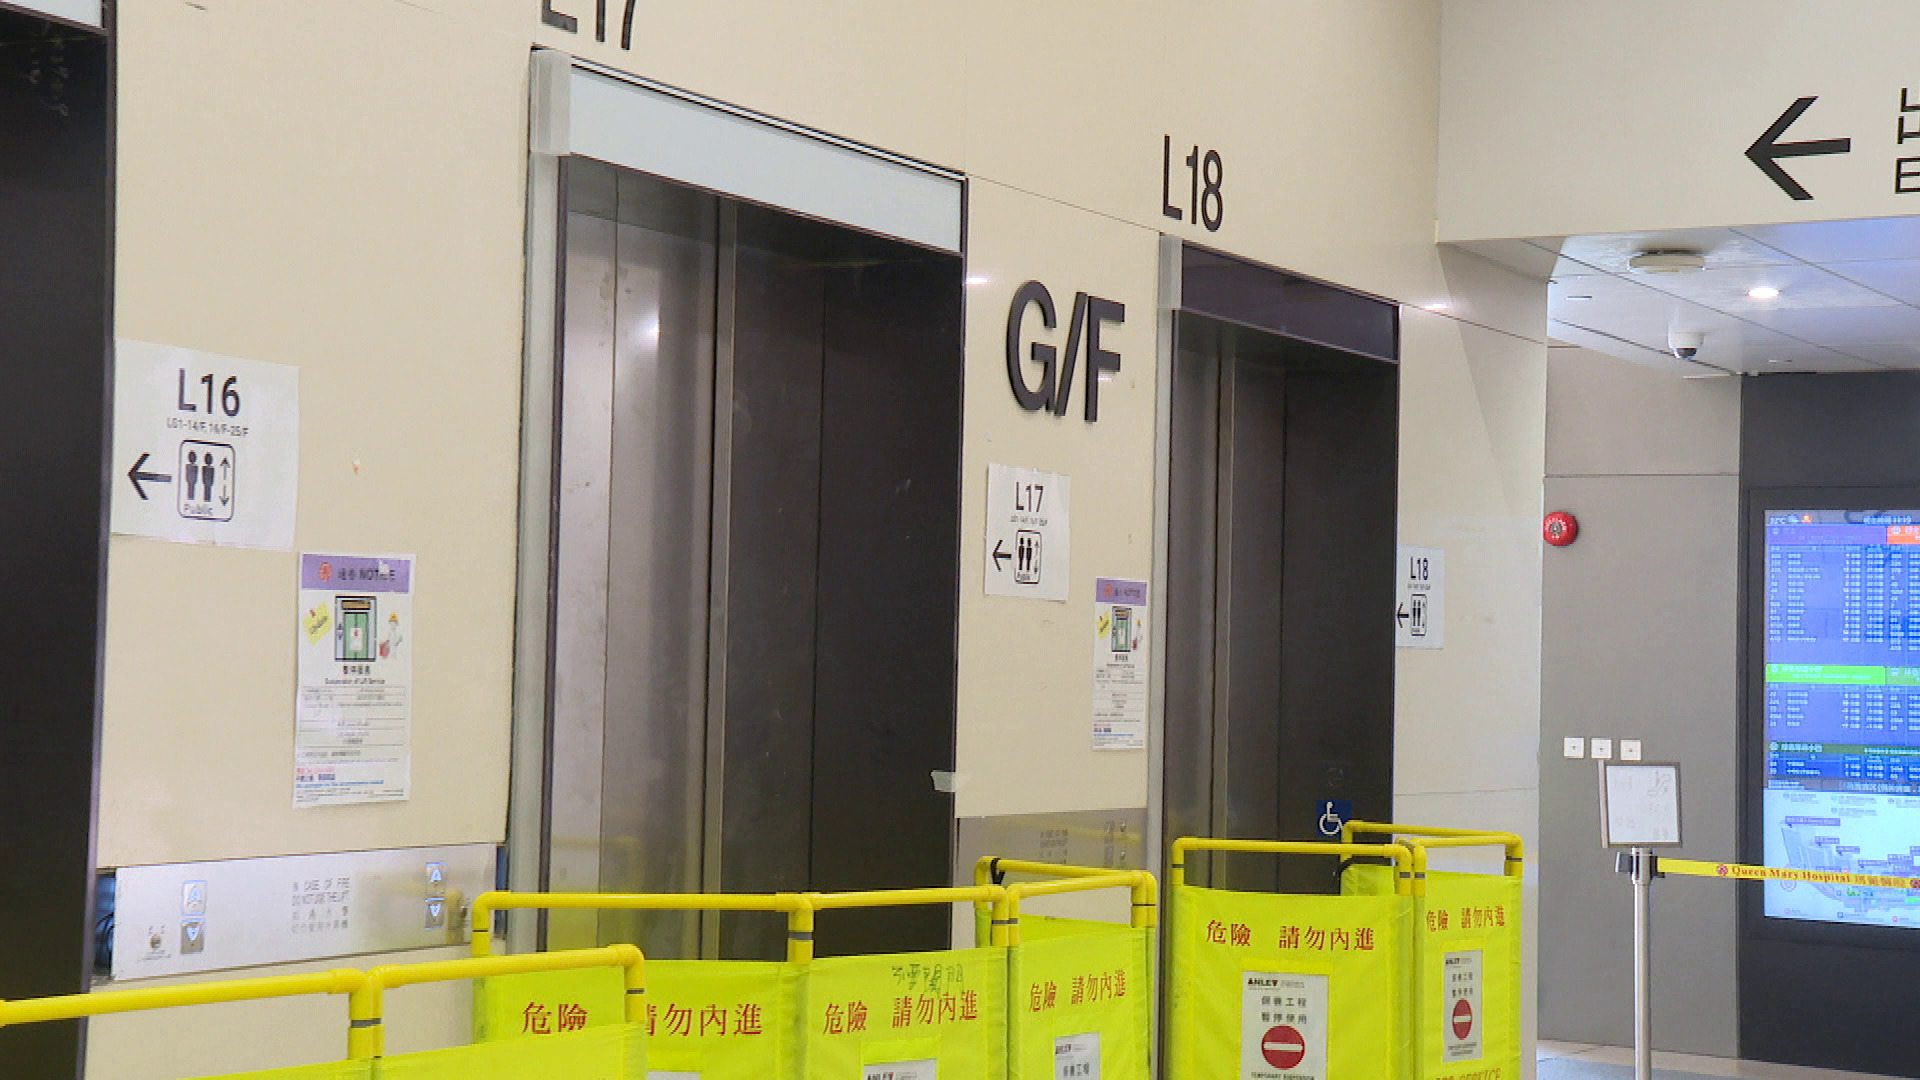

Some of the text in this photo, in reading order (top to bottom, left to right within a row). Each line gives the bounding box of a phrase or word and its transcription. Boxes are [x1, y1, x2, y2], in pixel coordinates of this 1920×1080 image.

[1163, 134, 1223, 232] L18
[1006, 280, 1126, 422] G/F
[178, 367, 240, 417] L16
[1016, 481, 1043, 512] L17
[1410, 556, 1428, 581] L18
[1731, 866, 1767, 878] Queen
[1770, 868, 1799, 881] Mary
[1802, 871, 1851, 884] Hospital
[1425, 905, 1505, 932] 危險 請勿內進
[1207, 919, 1375, 951] 危險 請勿內進
[1029, 968, 1126, 1012] 危險 請勿內進
[1248, 978, 1278, 987] ANLEV
[522, 1002, 588, 1034] 危險
[823, 990, 978, 1034] 危險 請勿內進
